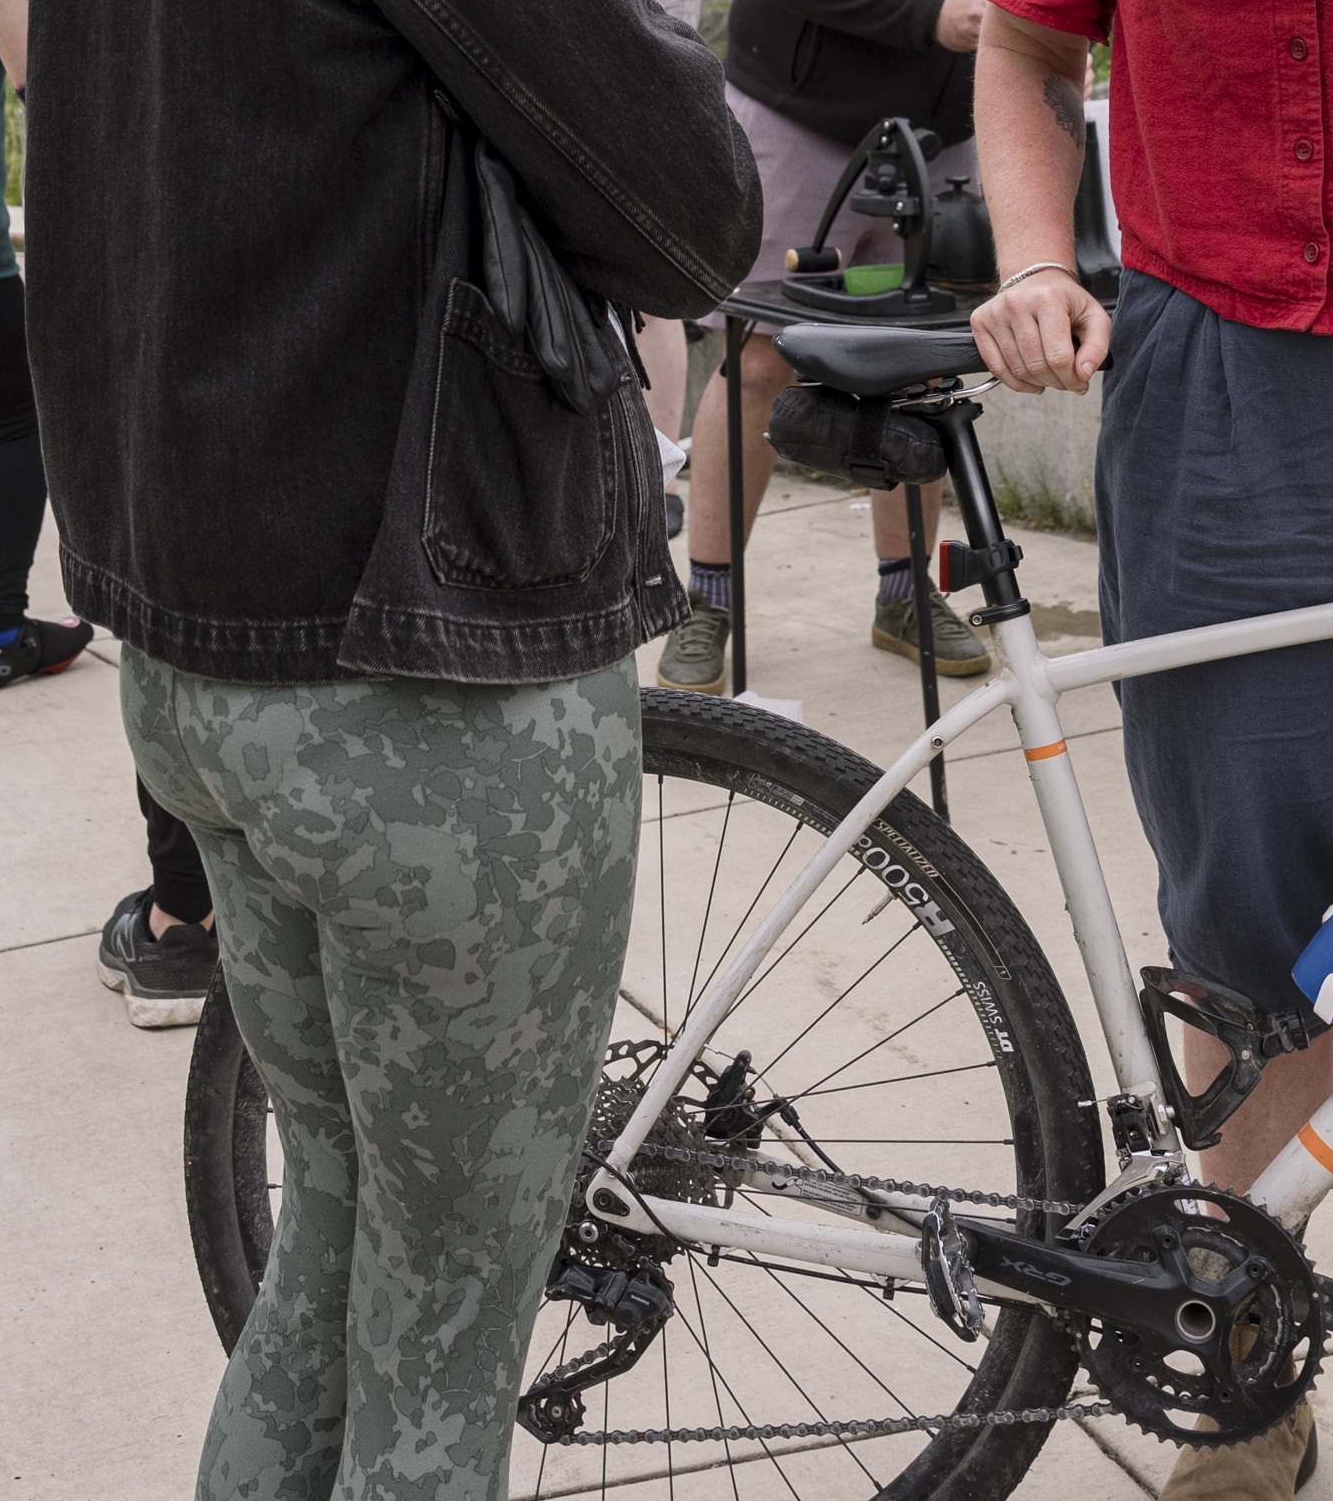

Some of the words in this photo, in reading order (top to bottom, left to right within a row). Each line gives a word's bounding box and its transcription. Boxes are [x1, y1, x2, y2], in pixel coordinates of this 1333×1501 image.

[877, 820, 941, 880] SPECIALIZED
[972, 981, 1003, 1025] SWISS
[992, 1028, 1015, 1053] DT
[999, 1255, 1072, 1287] GRX
